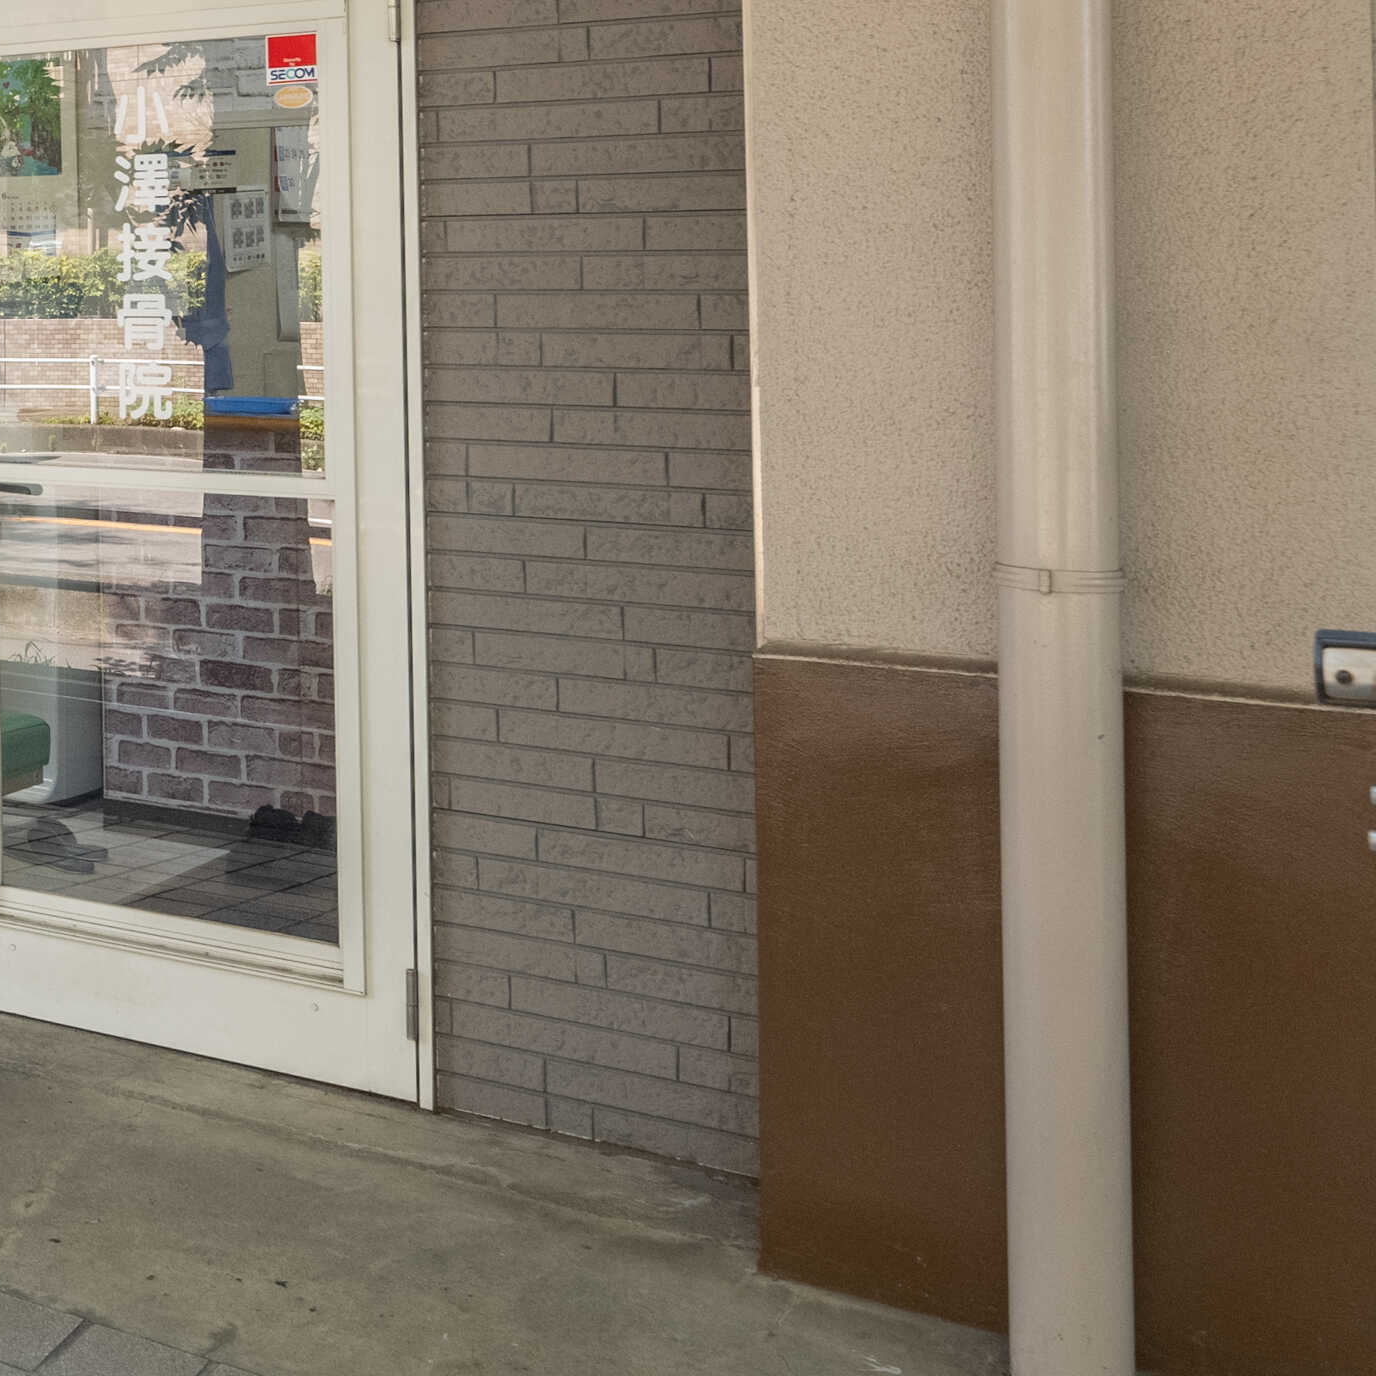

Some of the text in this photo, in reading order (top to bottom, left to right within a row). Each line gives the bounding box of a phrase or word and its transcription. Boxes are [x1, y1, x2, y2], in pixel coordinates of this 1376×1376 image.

[270, 67, 315, 80] SECOM
[114, 86, 173, 421] 小澤接骨院
